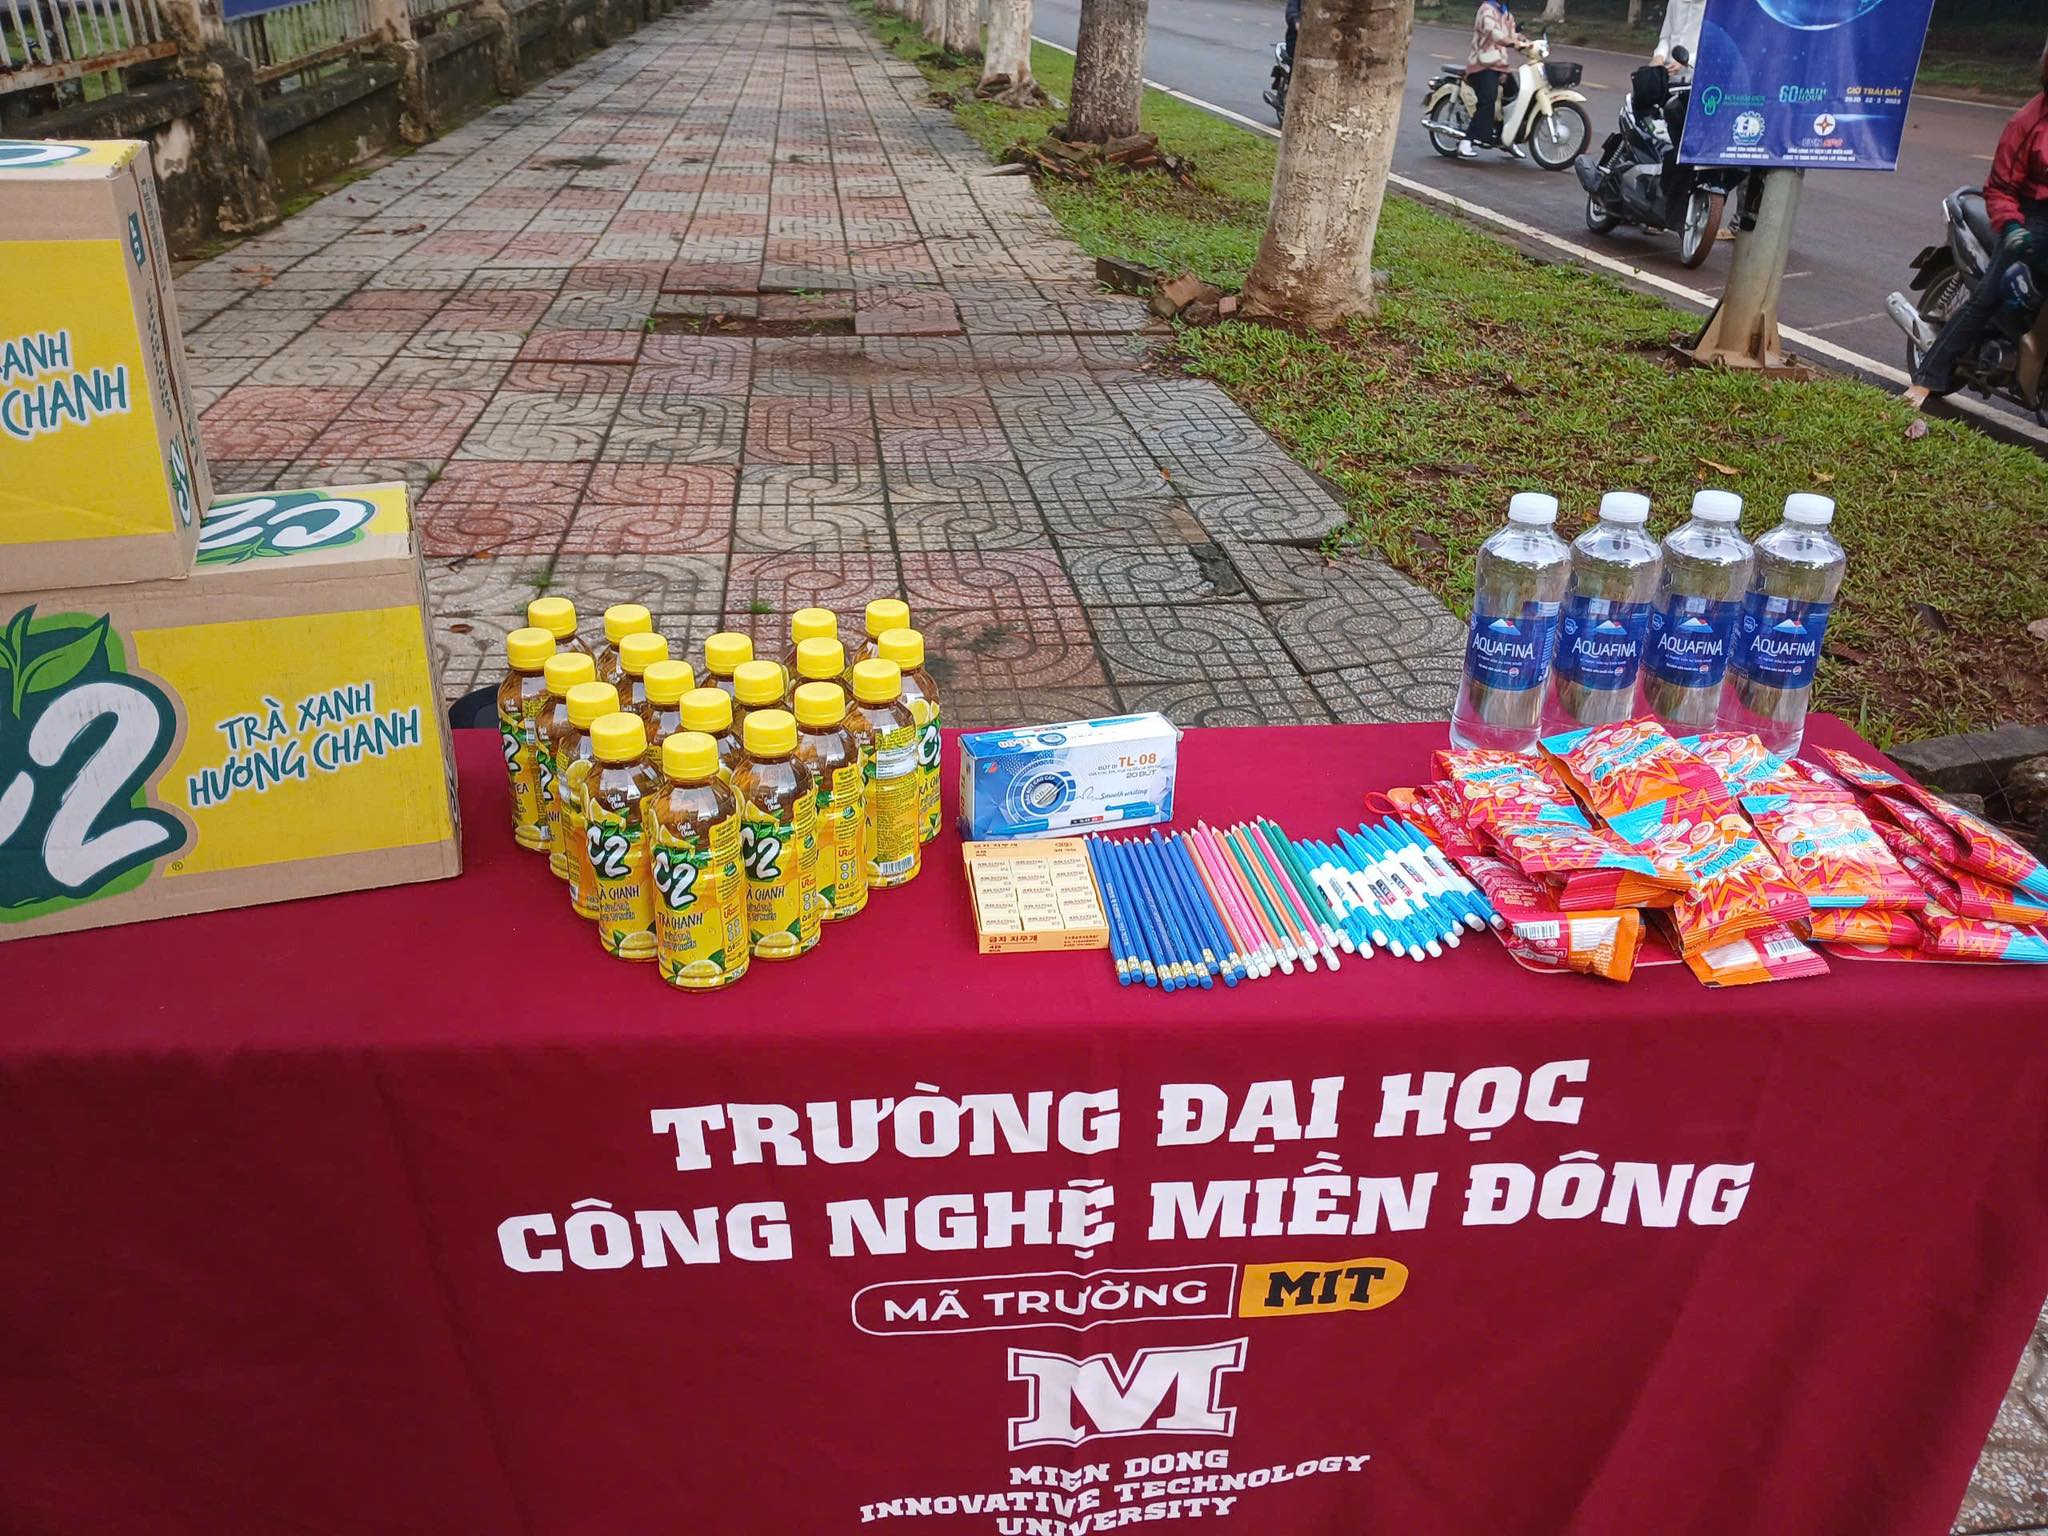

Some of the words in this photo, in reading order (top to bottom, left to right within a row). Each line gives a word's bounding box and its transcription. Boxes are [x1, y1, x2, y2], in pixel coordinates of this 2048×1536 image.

[1779, 85, 1799, 103] 60
[2, 366, 127, 436] CHANH
[1472, 633, 1535, 660] AQUAFINA
[1571, 637, 1637, 659] AQUAFINA
[1657, 633, 1723, 656] AQUAFINA
[1750, 634, 1816, 657] AQUAFINA
[219, 698, 287, 750] TRÀ
[299, 683, 372, 731] XANH
[189, 741, 306, 806] HƯƠNG
[313, 709, 420, 770] CHANH
[1119, 752, 1157, 768] TL-08
[587, 826, 632, 879] C2
[740, 827, 781, 880] C2
[608, 885, 640, 900] CHANH
[653, 852, 698, 909] C2
[754, 887, 785, 900] CHANH
[672, 912, 704, 928] CHANH
[650, 1081, 1120, 1171] TRƯỜNG
[1156, 1076, 1345, 1153] ĐẠI
[1373, 1059, 1590, 1142] HỌC
[497, 1198, 793, 1273] CÔNG
[826, 1179, 1115, 1259] NGHỆ
[1147, 1152, 1438, 1241] MIỀN
[1462, 1150, 1755, 1228] ĐÔNG
[884, 1288, 969, 1323] MÃ
[984, 1279, 1207, 1316] TRƯỜNG
[1264, 1266, 1386, 1308] MIT
[860, 1488, 1100, 1519] INNOVATIVE
[1114, 1454, 1371, 1502] TECHNOLOGY
[1009, 1463, 1110, 1493] MIEN
[1124, 1449, 1230, 1478] DONG
[996, 1497, 1237, 1536] UNIVERSITY
